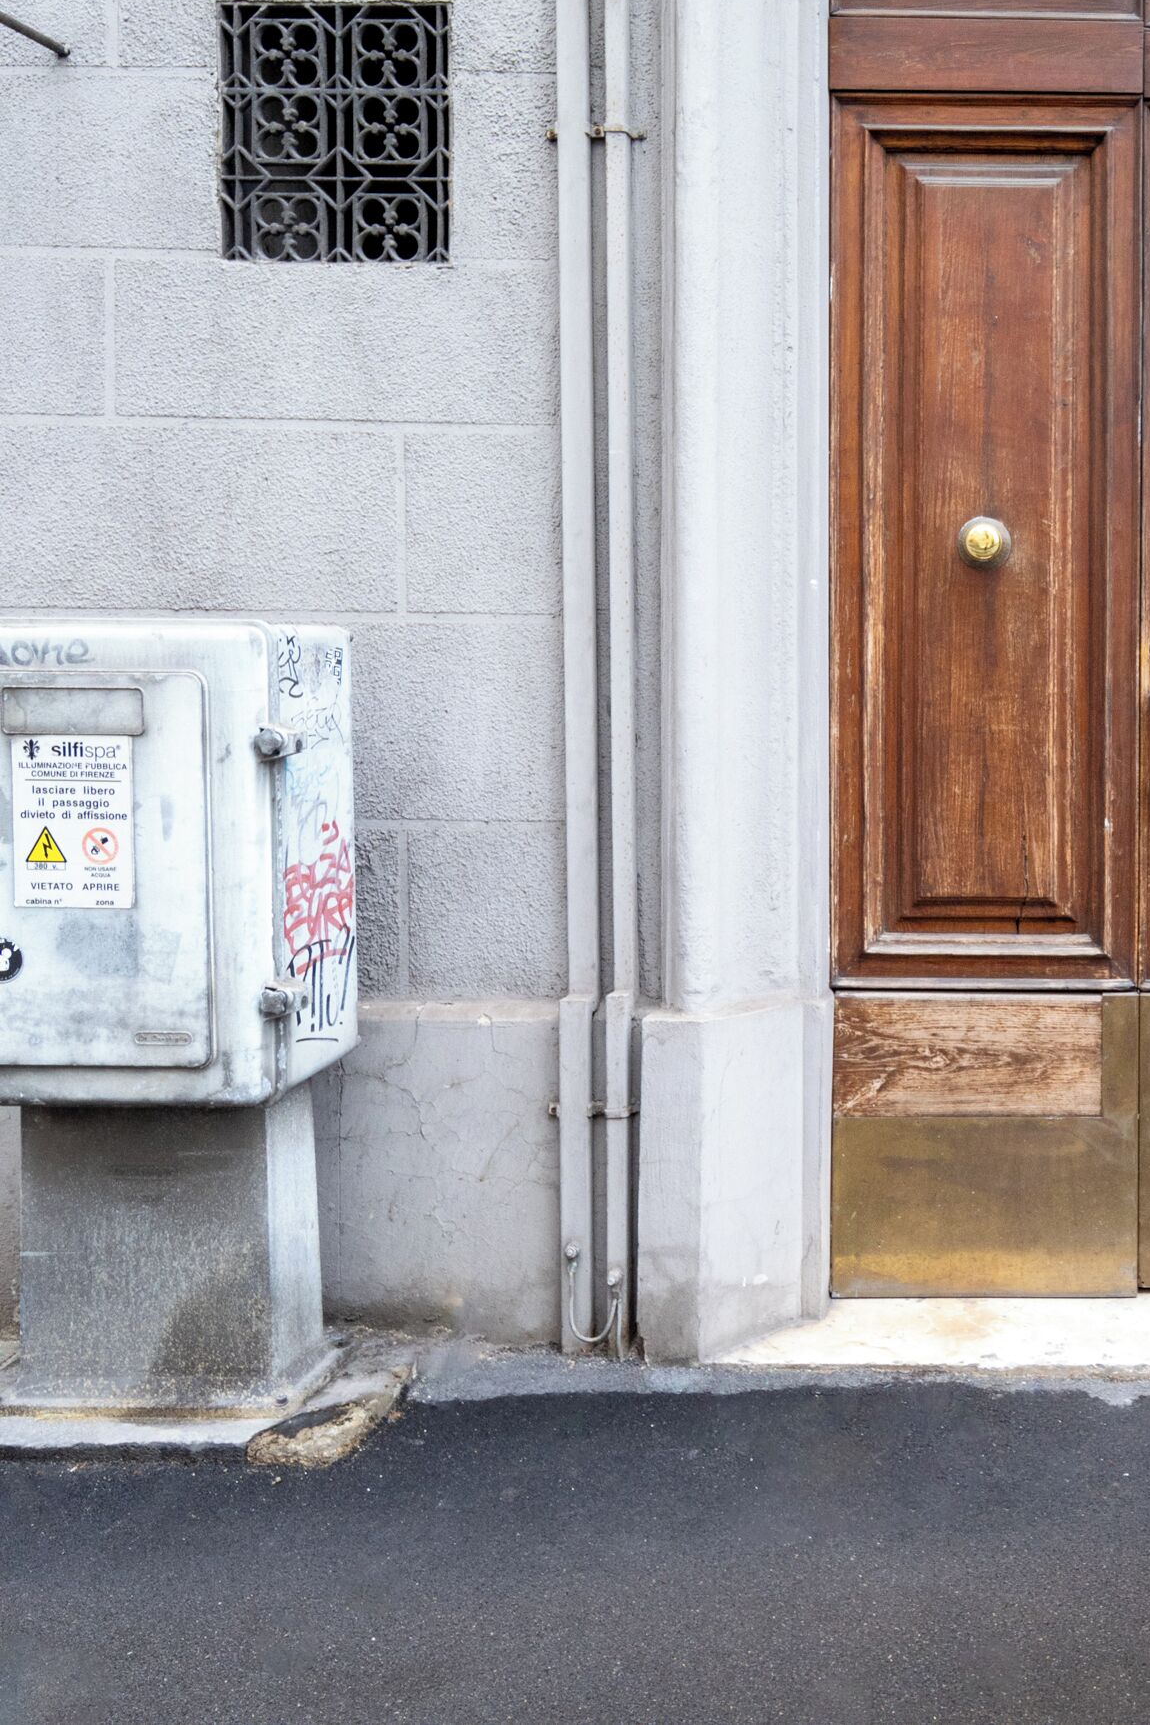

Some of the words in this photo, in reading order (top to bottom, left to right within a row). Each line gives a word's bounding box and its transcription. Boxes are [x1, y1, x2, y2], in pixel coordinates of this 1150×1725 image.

[18, 762, 83, 770] ILLUMINAZIONE
[31, 770, 67, 778] COMUNE
[80, 771, 116, 779] FIRENZE
[31, 785, 76, 795] lasciare
[83, 785, 116, 795] libero
[38, 798, 45, 807] il
[52, 799, 110, 810] passaggio
[20, 810, 56, 819] divieto
[61, 810, 71, 819] di
[77, 811, 128, 820] affissione
[30, 882, 74, 891] VIETATO
[82, 883, 120, 892] APRIRE
